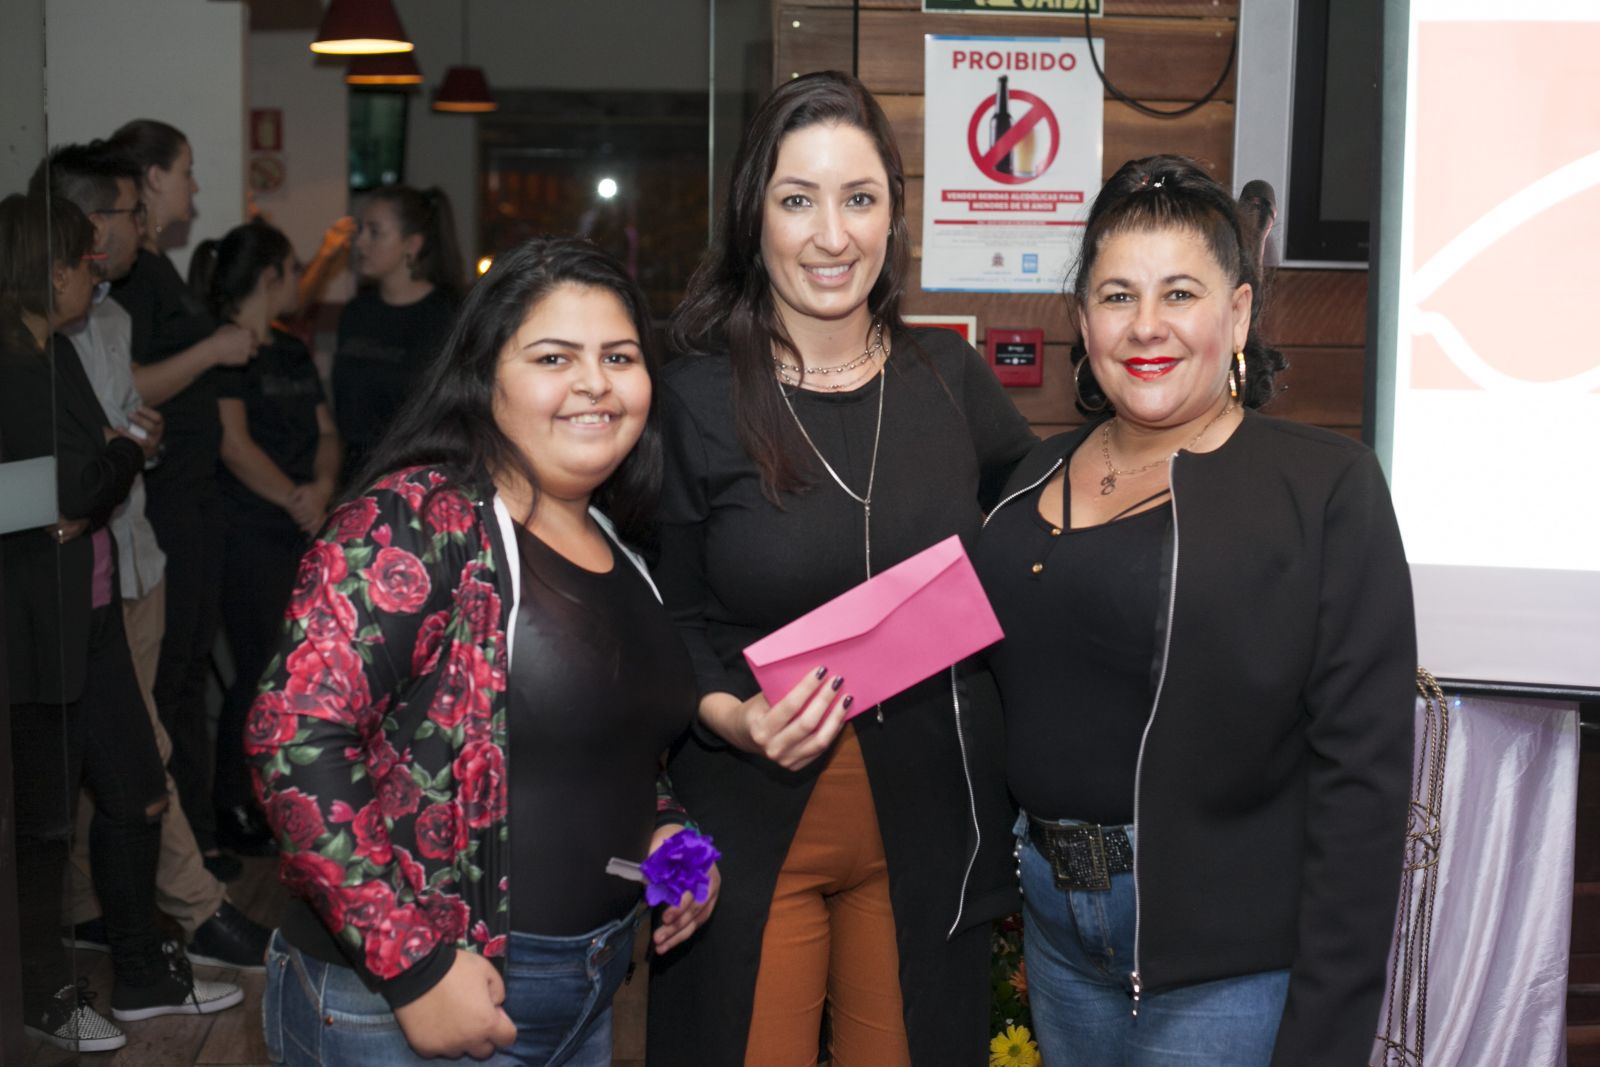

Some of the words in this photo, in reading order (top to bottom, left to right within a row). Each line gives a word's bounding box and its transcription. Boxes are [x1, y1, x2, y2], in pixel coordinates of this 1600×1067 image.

[952, 50, 1077, 72] PROIBIDO
[946, 191, 977, 200] VENDER
[978, 191, 1009, 200] BEBIDAS
[1059, 192, 1080, 202] PARA
[972, 202, 1009, 210] MENORES
[1010, 202, 1022, 210] DE
[1031, 203, 1054, 211] ANOS
